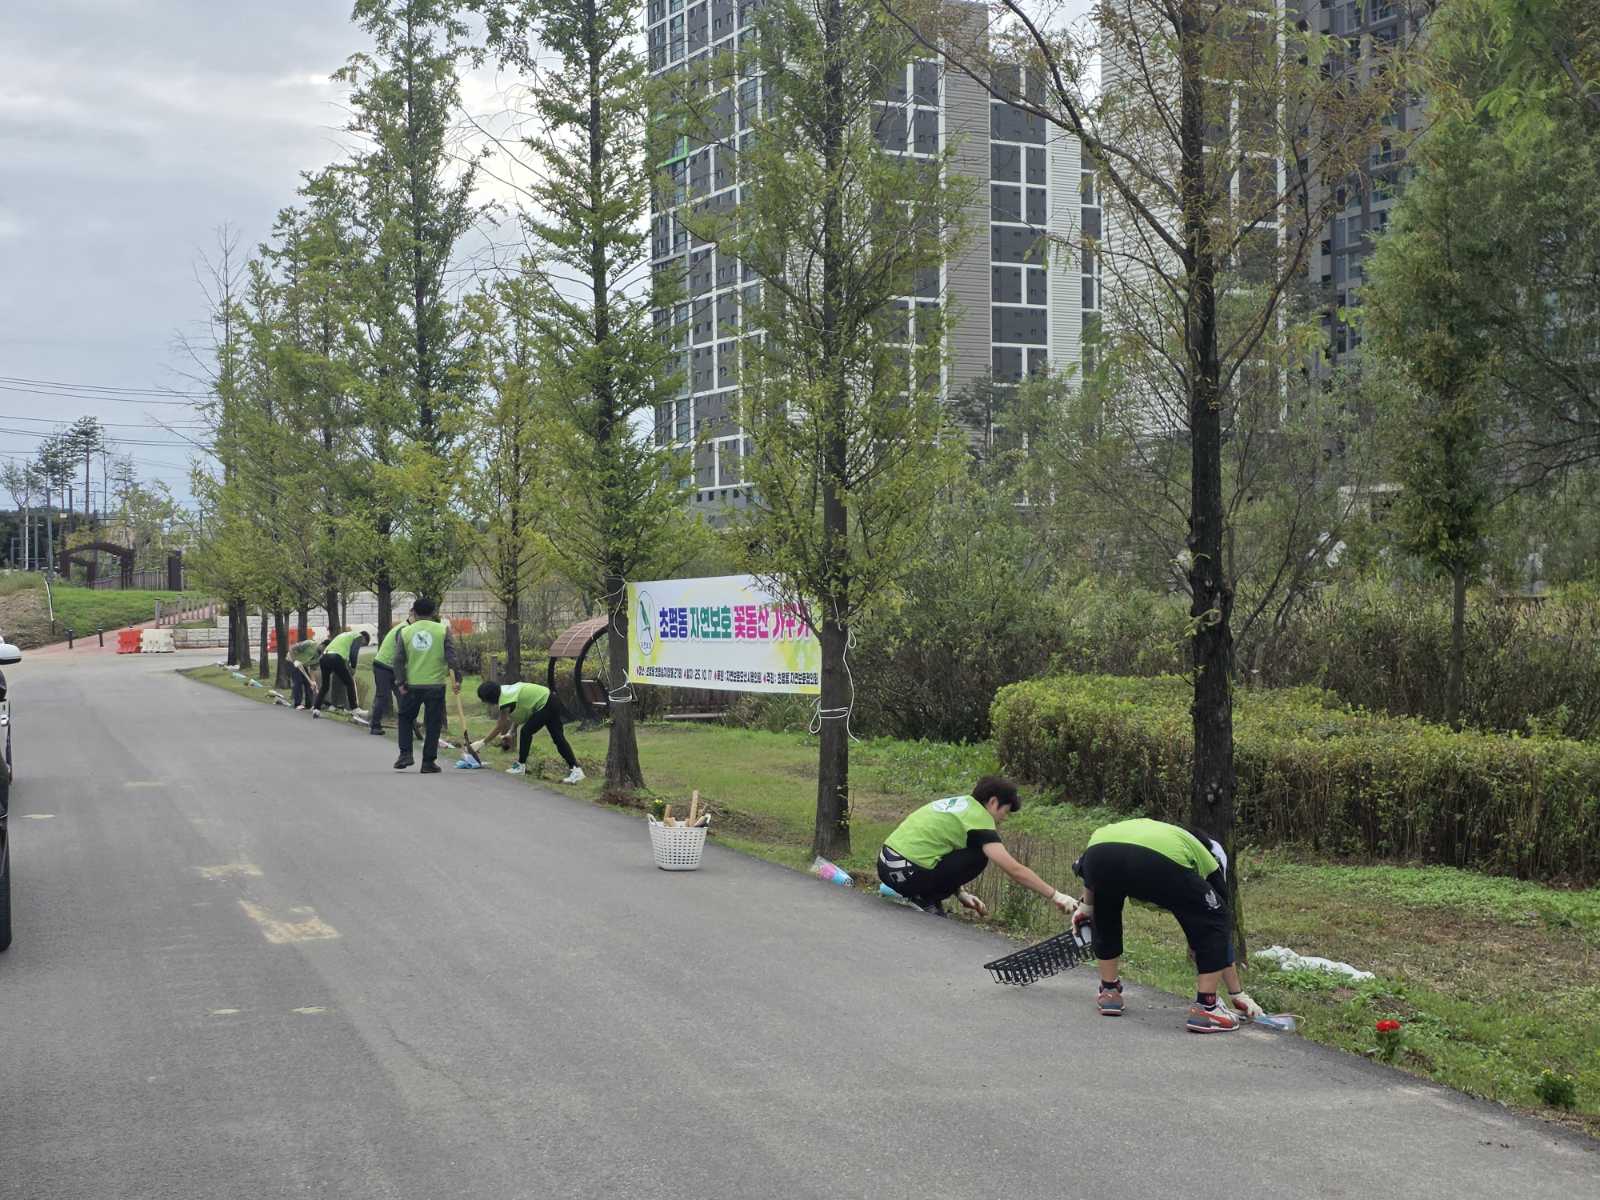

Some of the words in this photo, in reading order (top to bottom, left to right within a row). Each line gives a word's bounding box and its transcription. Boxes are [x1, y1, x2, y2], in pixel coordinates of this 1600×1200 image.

[659, 607, 688, 638] 초평동
[690, 606, 731, 638] 자연보호
[734, 605, 769, 638] 꽃동산
